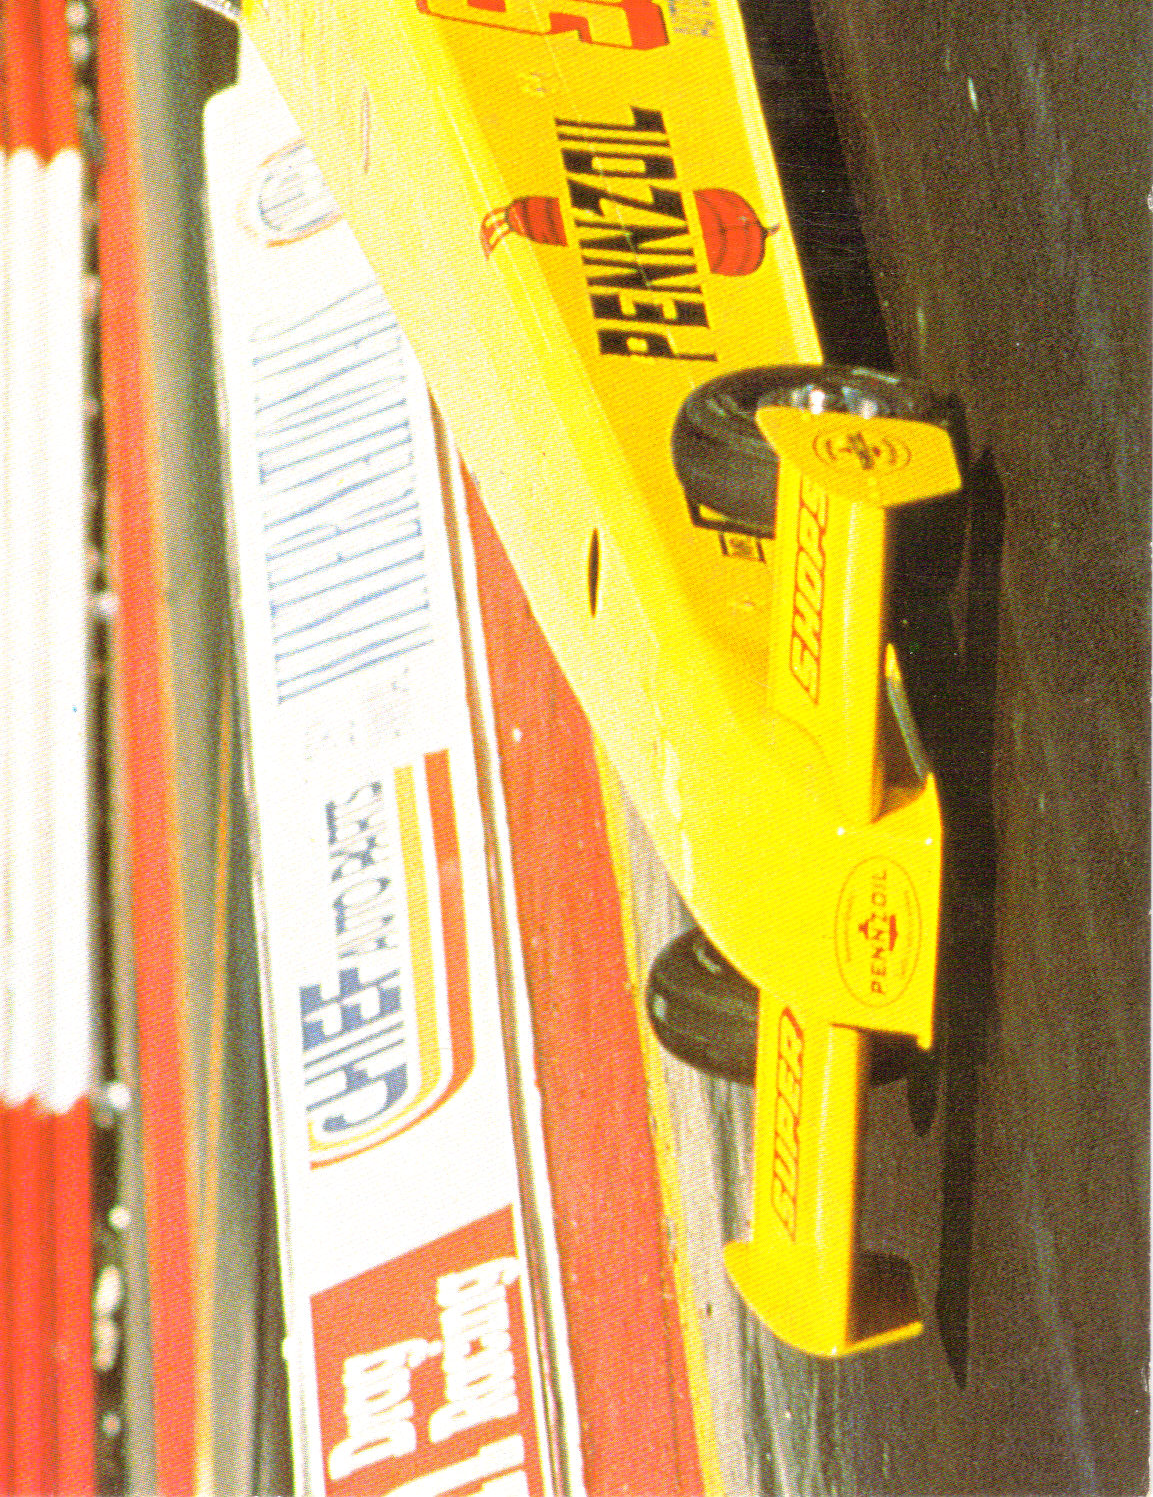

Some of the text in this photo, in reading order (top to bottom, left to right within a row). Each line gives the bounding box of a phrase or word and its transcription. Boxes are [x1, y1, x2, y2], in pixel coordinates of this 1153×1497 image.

[553, 105, 718, 363] PENNZOIL
[331, 876, 399, 959] AUTO
[770, 476, 829, 1242] SUPER SHOPS
[869, 868, 889, 995] PENNZOIL
[299, 965, 407, 1134] CHIEF
[327, 1338, 444, 1480] Drag
[428, 1255, 519, 1443] Racing
